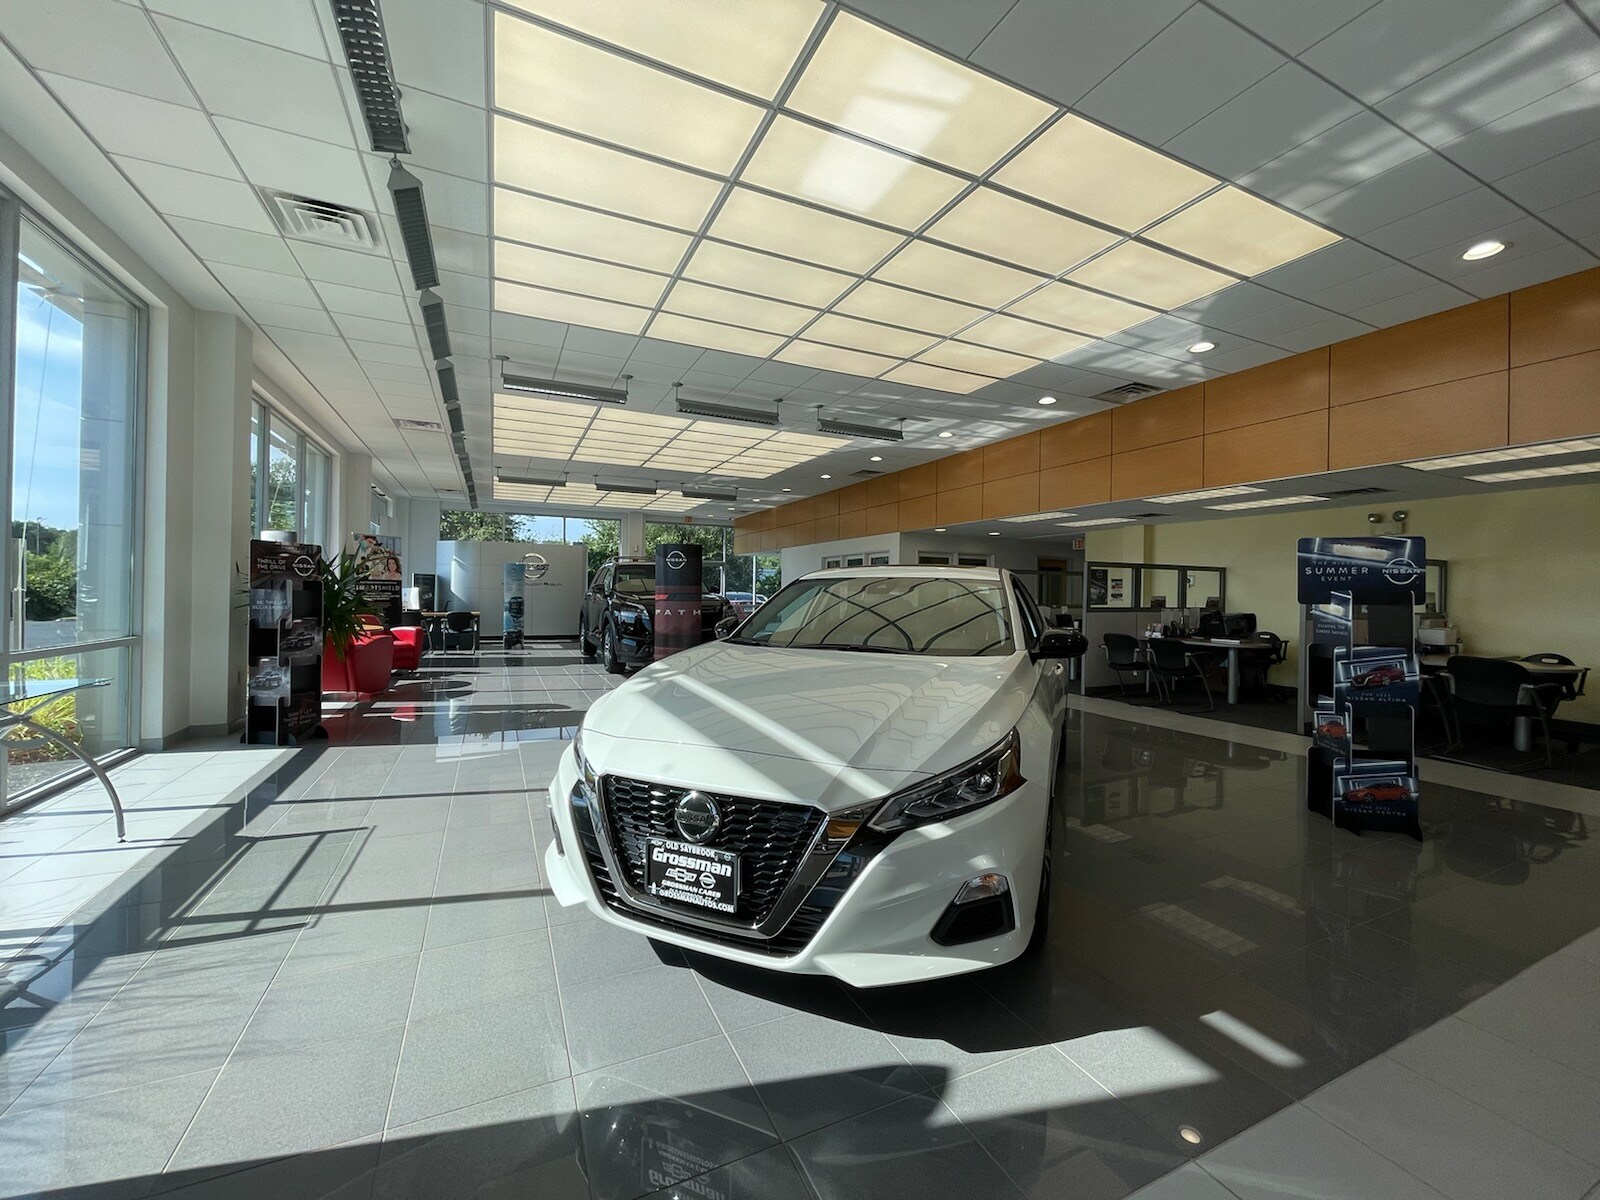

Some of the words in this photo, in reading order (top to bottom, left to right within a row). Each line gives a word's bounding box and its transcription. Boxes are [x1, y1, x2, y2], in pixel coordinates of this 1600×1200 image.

[1305, 567, 1369, 575] SUMMER
[665, 841, 680, 851] OLD
[680, 844, 716, 858] SAYBROOK
[652, 847, 732, 877] Grossman
[661, 879, 698, 893] GROSSMAN
[659, 889, 735, 913] GROSSMANAUTOS.COM
